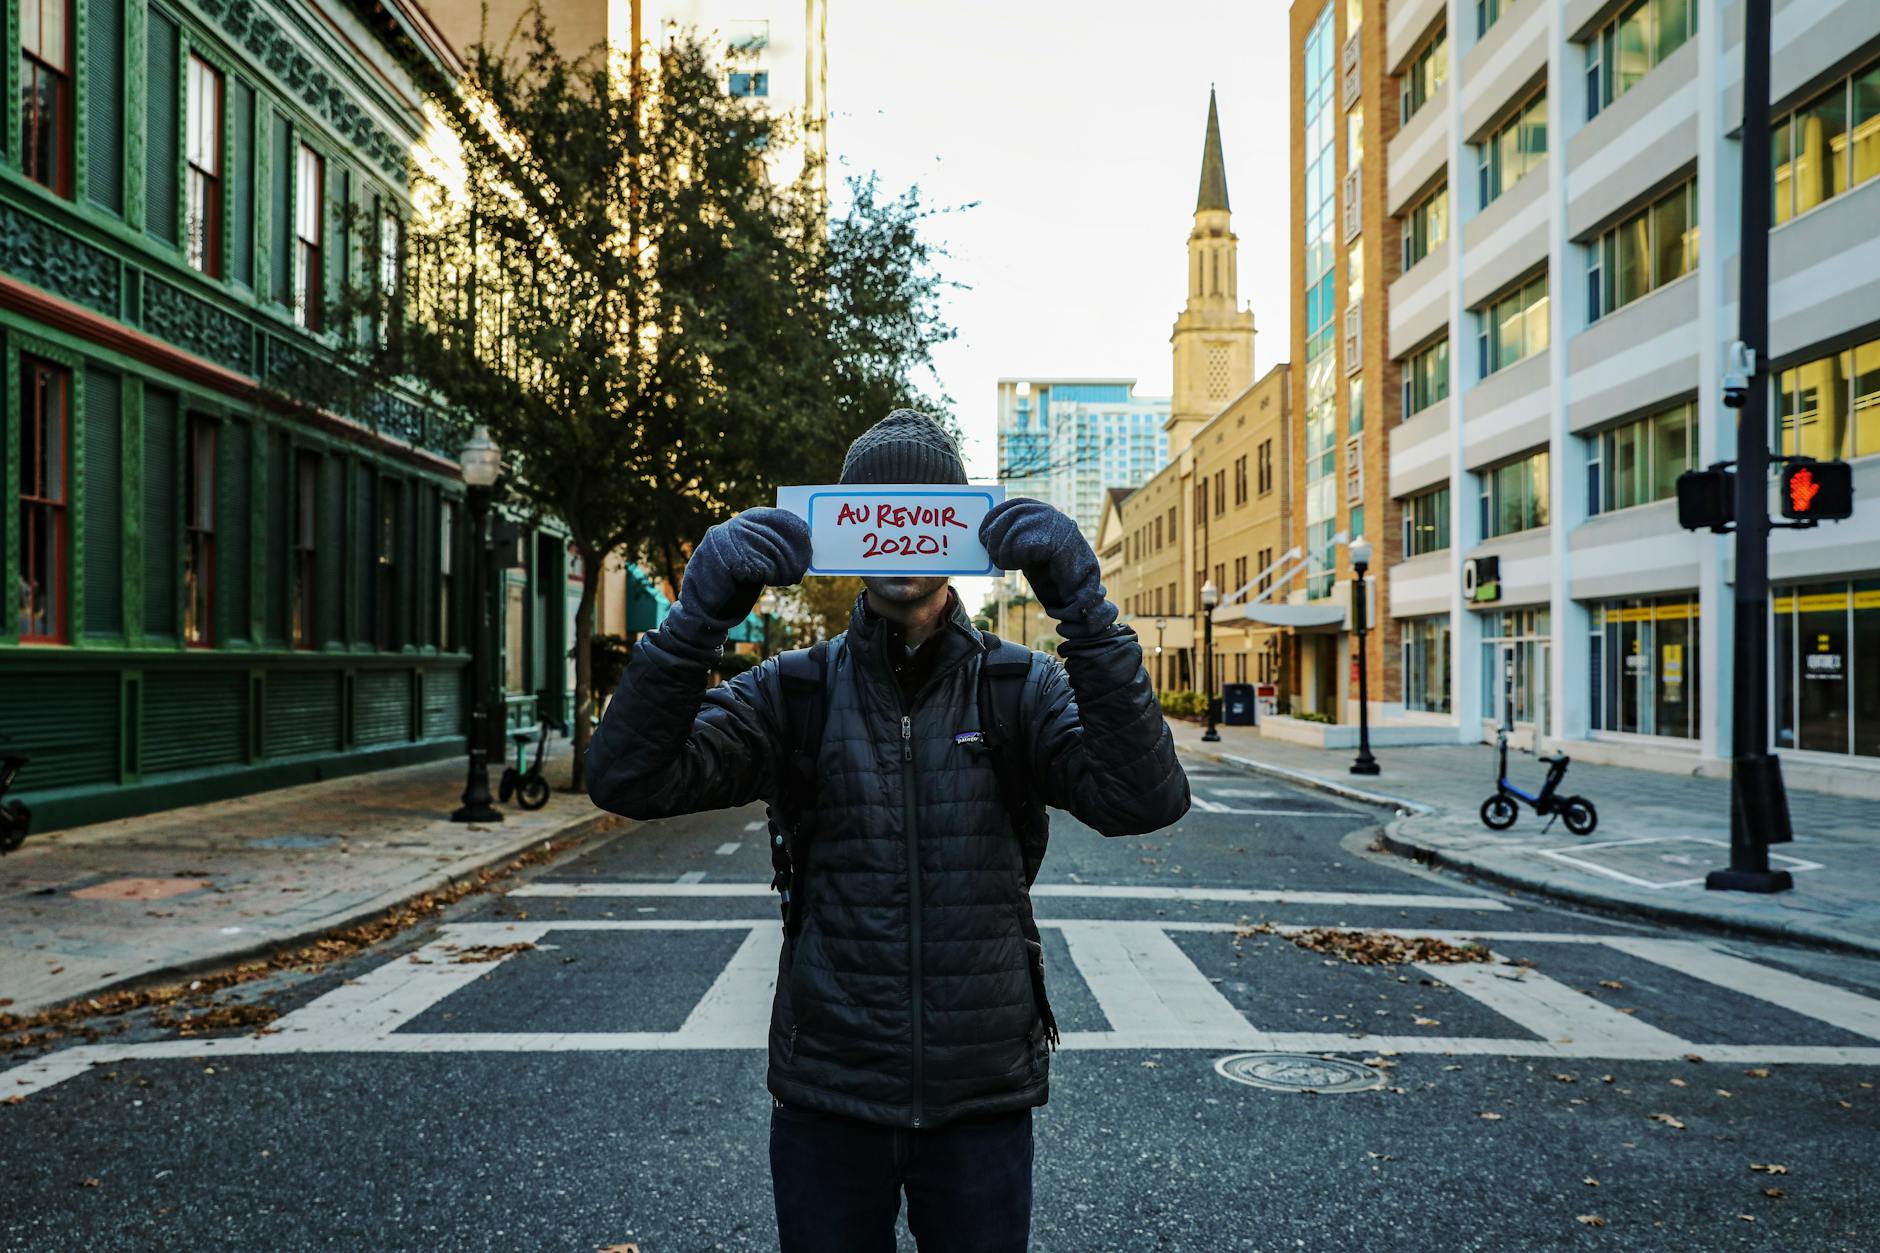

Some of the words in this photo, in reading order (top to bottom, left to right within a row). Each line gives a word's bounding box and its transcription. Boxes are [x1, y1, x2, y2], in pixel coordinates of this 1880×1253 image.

[837, 503, 871, 525] AU
[878, 504, 968, 529] REVOIR
[862, 532, 948, 558] 2020!
